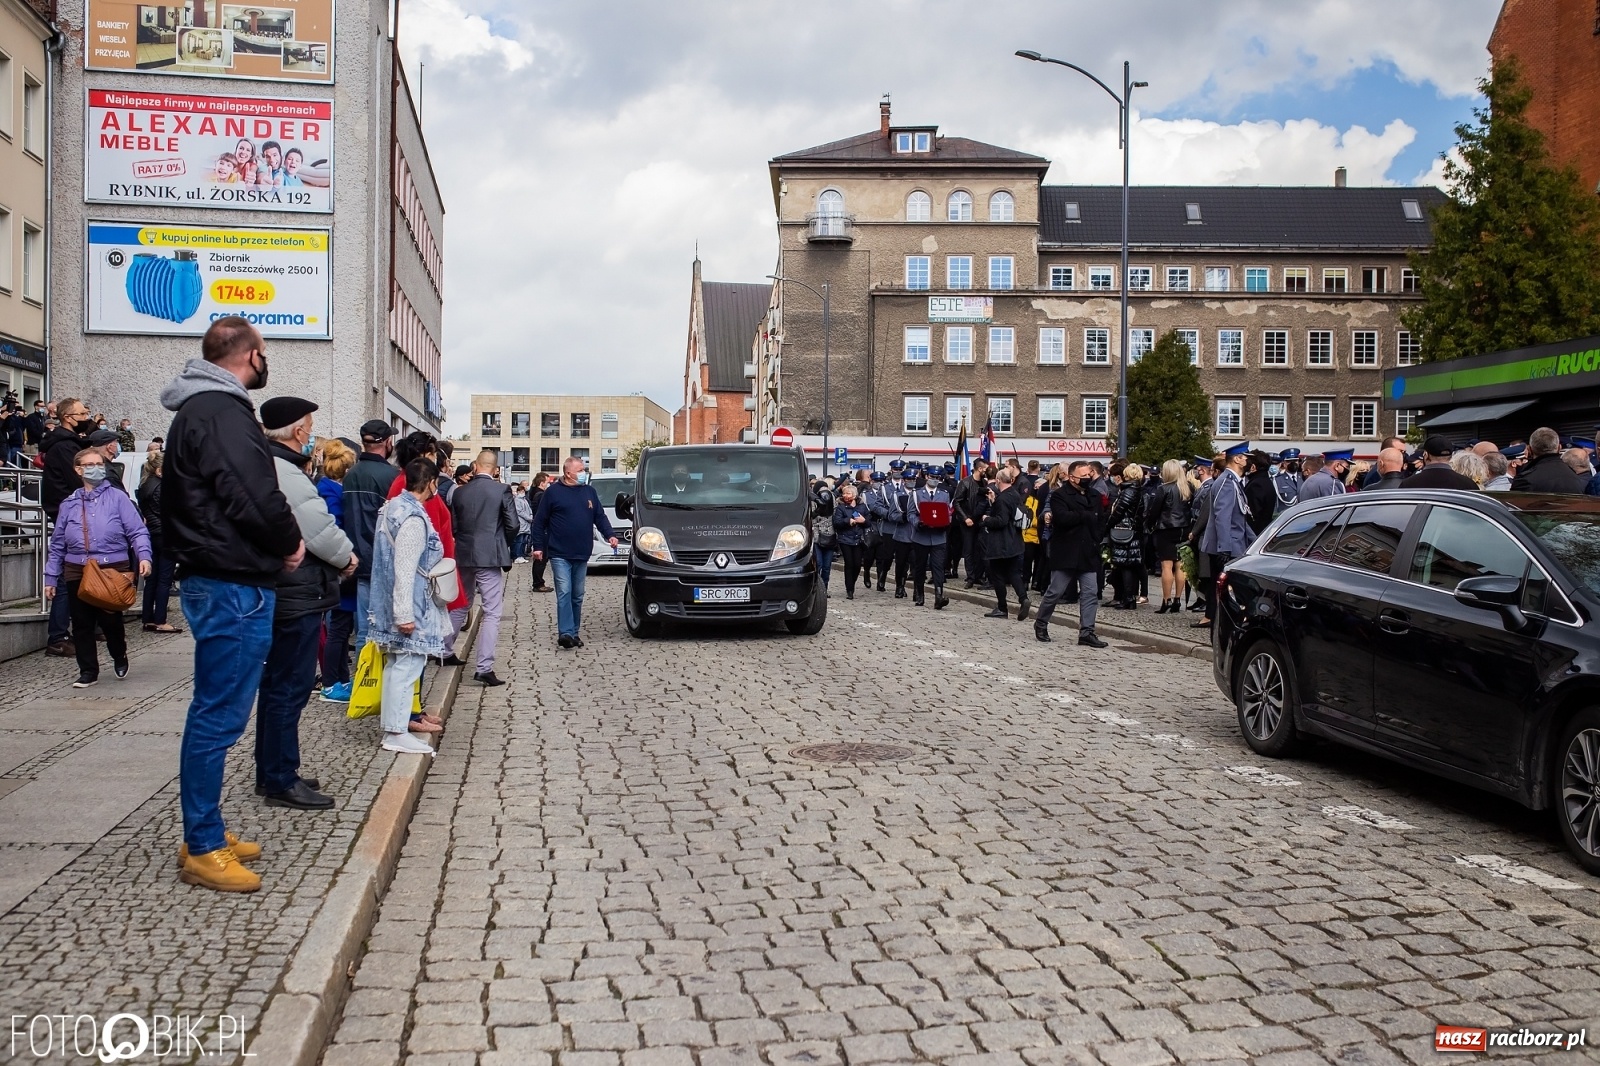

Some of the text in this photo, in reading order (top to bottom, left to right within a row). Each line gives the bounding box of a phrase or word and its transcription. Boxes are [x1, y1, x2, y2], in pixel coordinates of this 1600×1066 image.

[96, 20, 130, 31] BANKIETY
[99, 35, 127, 44] WESELA
[94, 48, 131, 59] PRZYJĘCIA
[105, 94, 316, 115] Najlepsze firmy w najlepszych cenach
[101, 111, 320, 141] ALEXANDER
[100, 135, 179, 152] MEBLE
[137, 163, 182, 175] RATY 0%
[109, 182, 311, 205] RYBNIK, ul. ŻORSKA 192
[162, 233, 305, 248] kupuj online lub przez telefon
[110, 254, 121, 263] 10
[209, 252, 250, 263] Zbiornik
[224, 264, 285, 275] deszczówkę
[287, 266, 314, 275] 2500
[216, 285, 269, 301] 1748 zł
[930, 298, 963, 311] ESTE
[209, 310, 305, 326] ctorama
[1048, 440, 1106, 451] ROSSMA
[838, 448, 845, 457] P
[701, 588, 749, 599] SRC 9RC3
